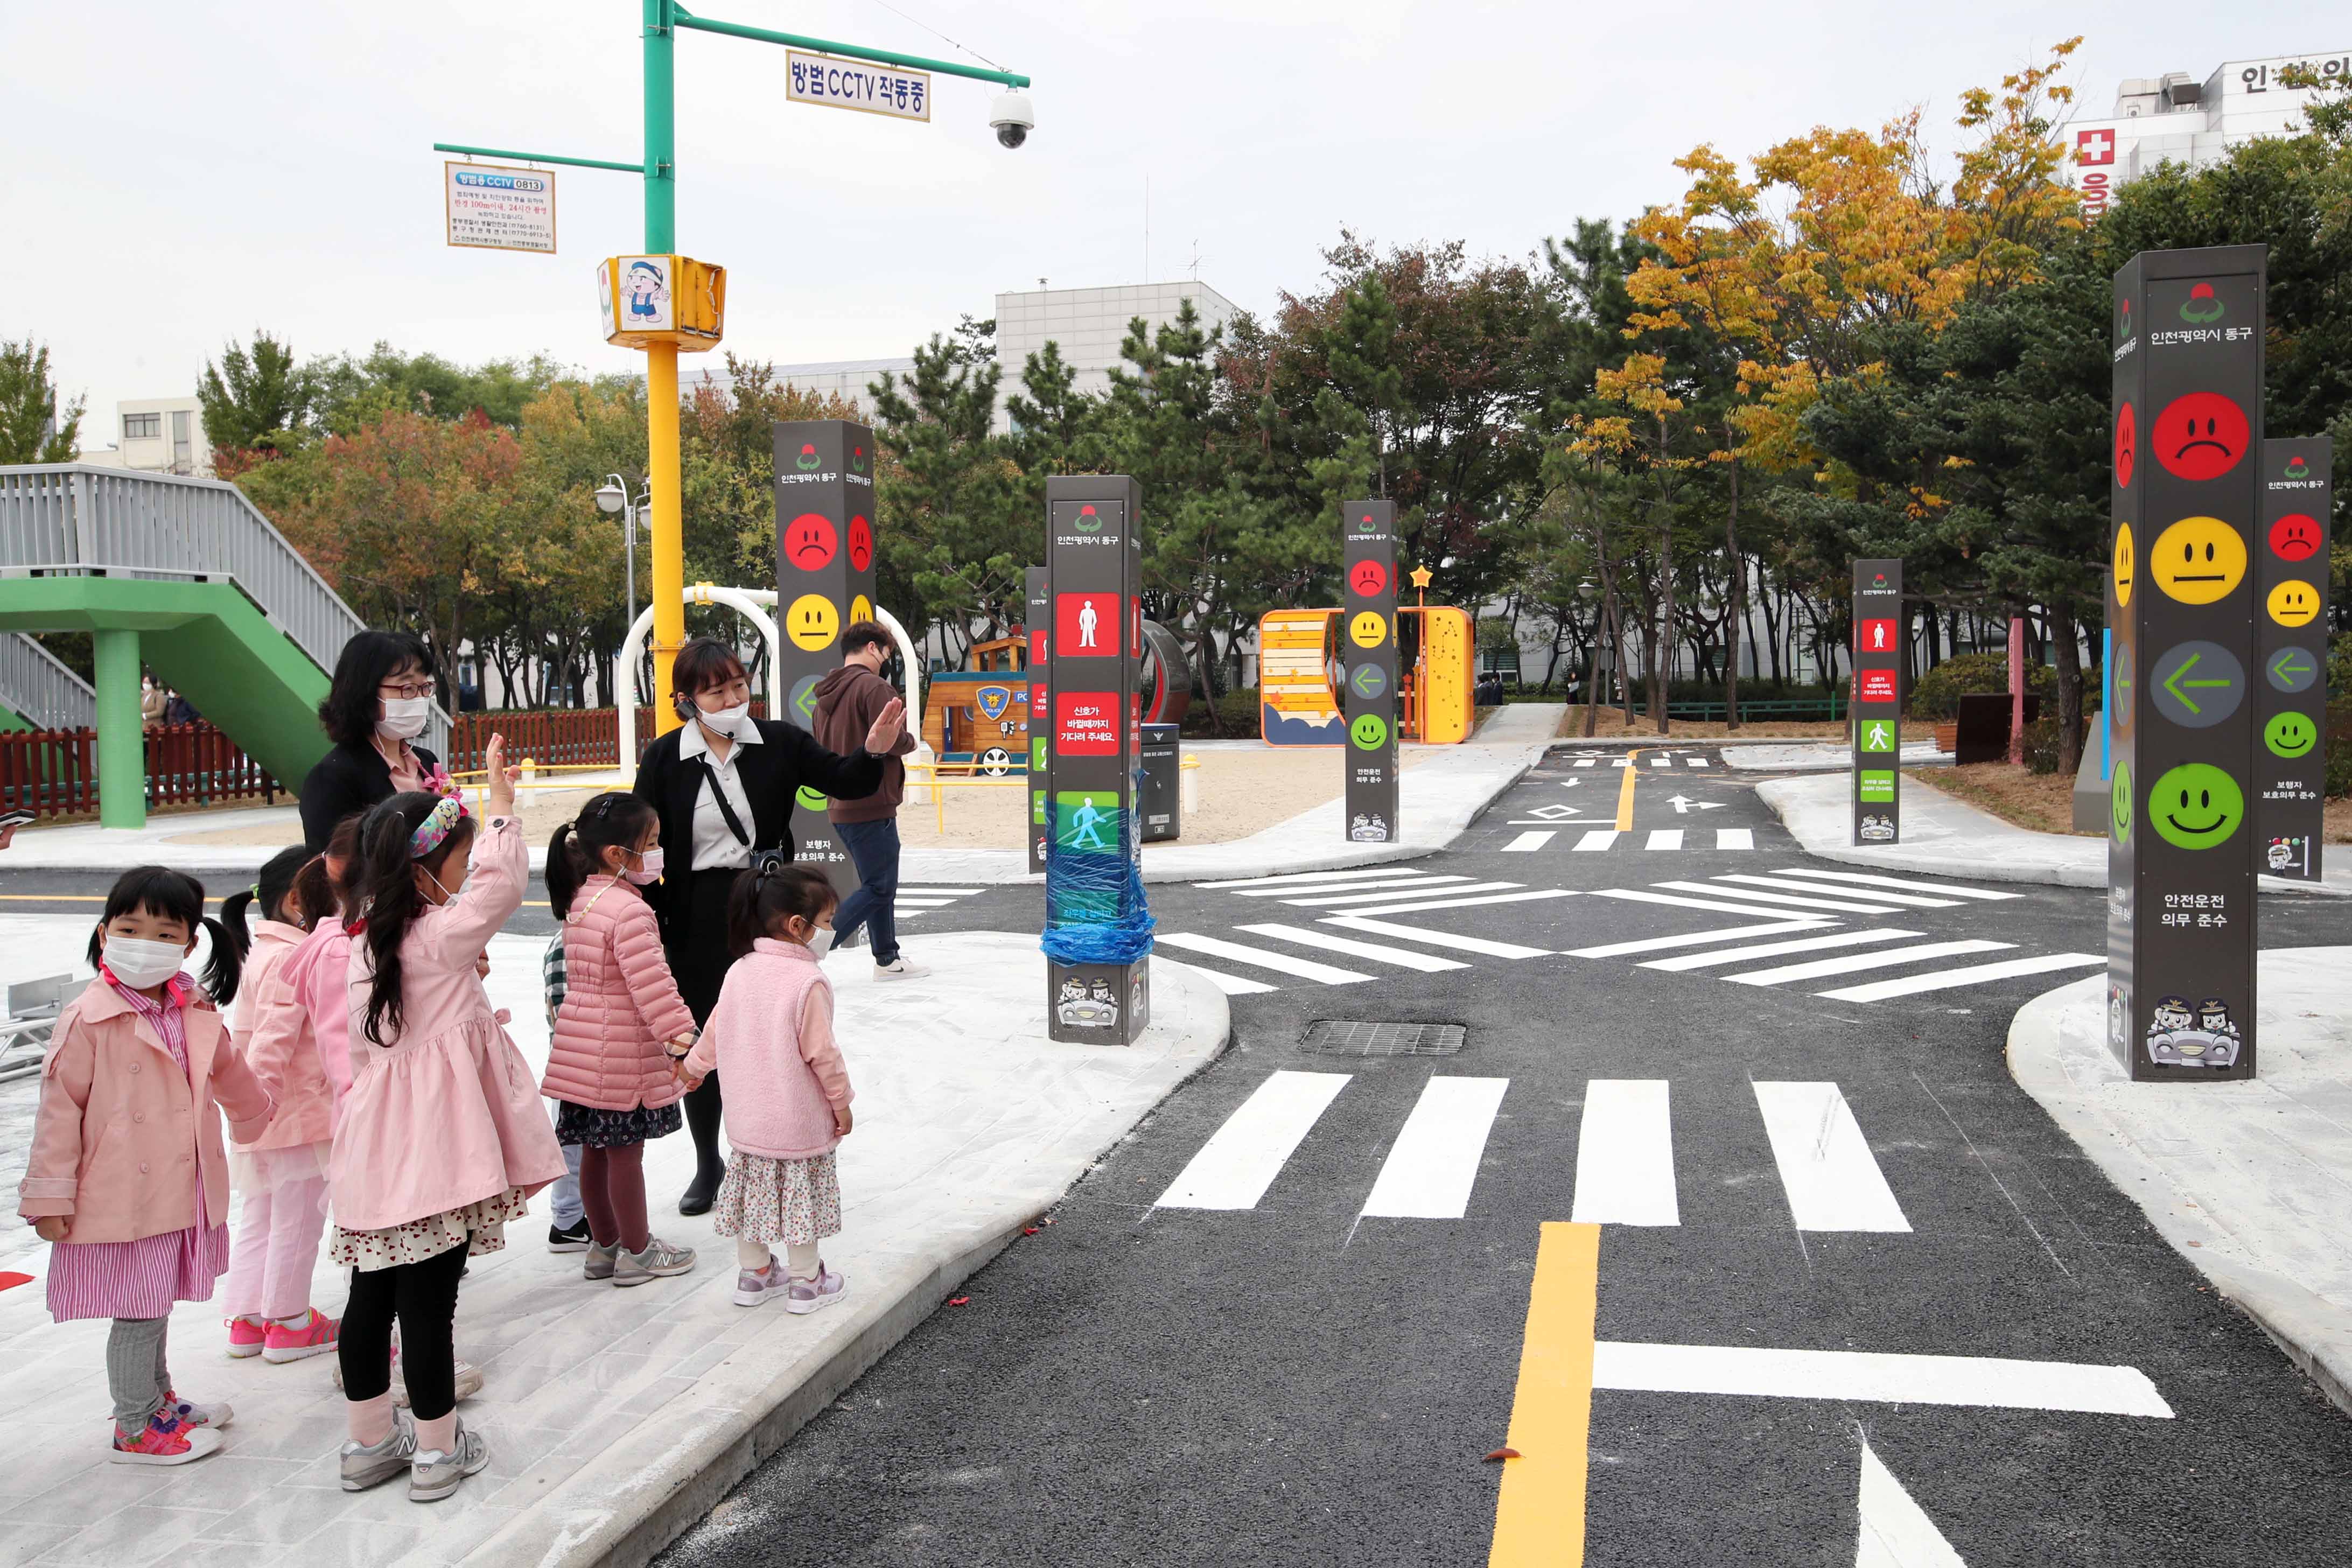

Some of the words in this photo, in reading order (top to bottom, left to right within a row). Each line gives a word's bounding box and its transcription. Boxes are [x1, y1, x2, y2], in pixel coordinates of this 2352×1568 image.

[460, 174, 485, 186] 방범용
[487, 177, 511, 187] CCTV
[516, 180, 539, 190] 0813
[509, 204, 530, 213] 24시간
[2151, 328, 2220, 345] 인천광역시
[2225, 327, 2252, 341] 동구
[781, 474, 820, 484] 인천광역시
[822, 473, 837, 482] 동구
[2268, 481, 2306, 489] 인천광역시
[2309, 480, 2324, 488] 동구
[1057, 536, 1099, 545] 인천광역시
[1102, 536, 1119, 545] 동구
[1074, 706, 1100, 716] 신호가
[1067, 719, 1109, 729] 바뀔때까지
[1060, 732, 1086, 741] 기다려
[1087, 732, 1115, 741] 주세요.
[2277, 781, 2303, 789] 보행자
[806, 839, 831, 849] 보행자
[794, 852, 825, 862] 보호의무
[828, 852, 845, 862] 준수
[2164, 894, 2225, 908] 안전운전
[2161, 913, 2191, 927] 의무
[2196, 913, 2228, 927] 준수
[655, 1252, 672, 1267] N
[396, 1435, 418, 1457] N
